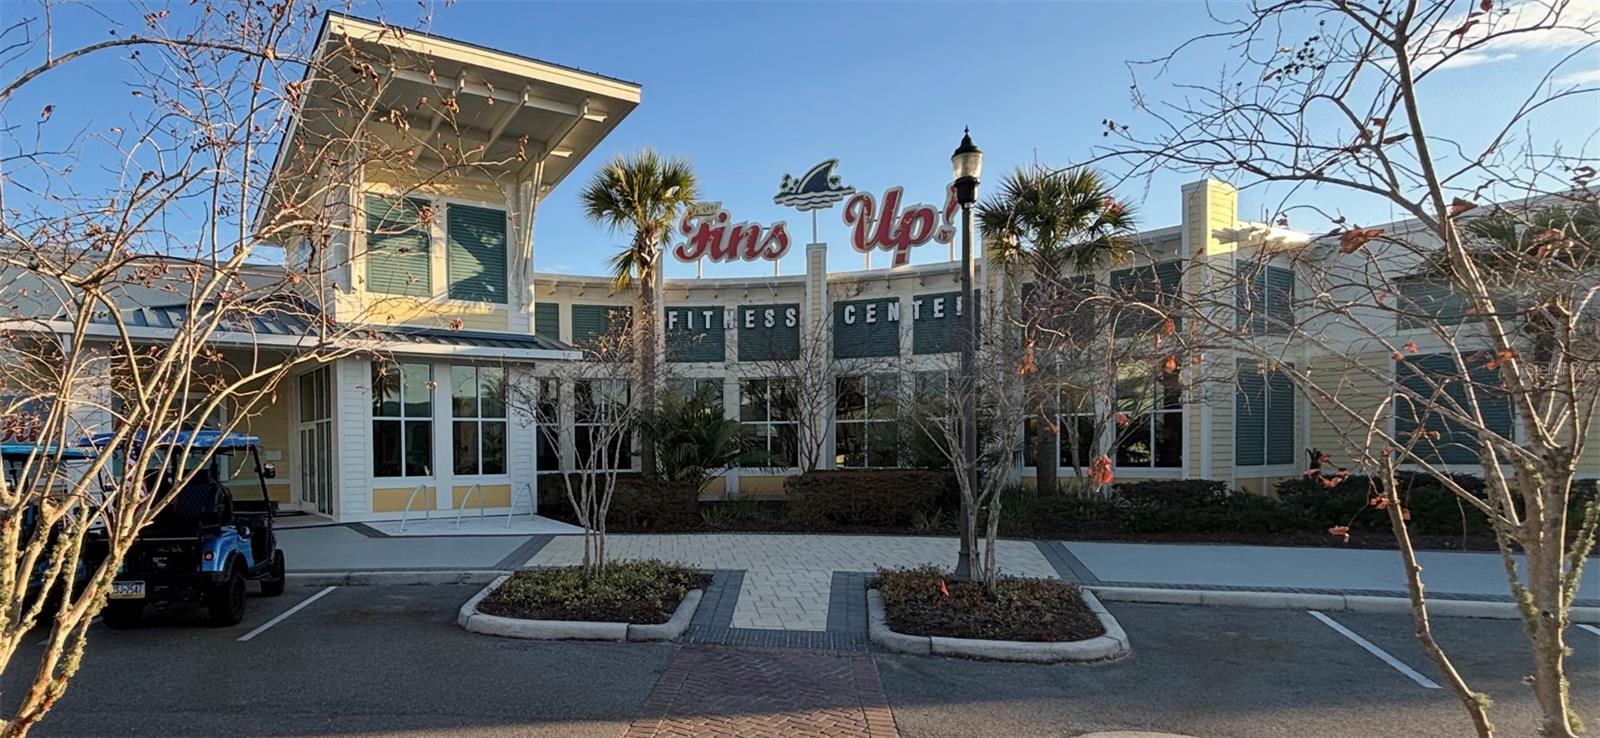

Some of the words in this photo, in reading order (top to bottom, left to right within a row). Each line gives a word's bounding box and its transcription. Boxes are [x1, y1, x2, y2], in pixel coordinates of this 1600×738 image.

[674, 210, 791, 262] Fins
[843, 182, 960, 266] Up!
[667, 307, 797, 330] FITNESS
